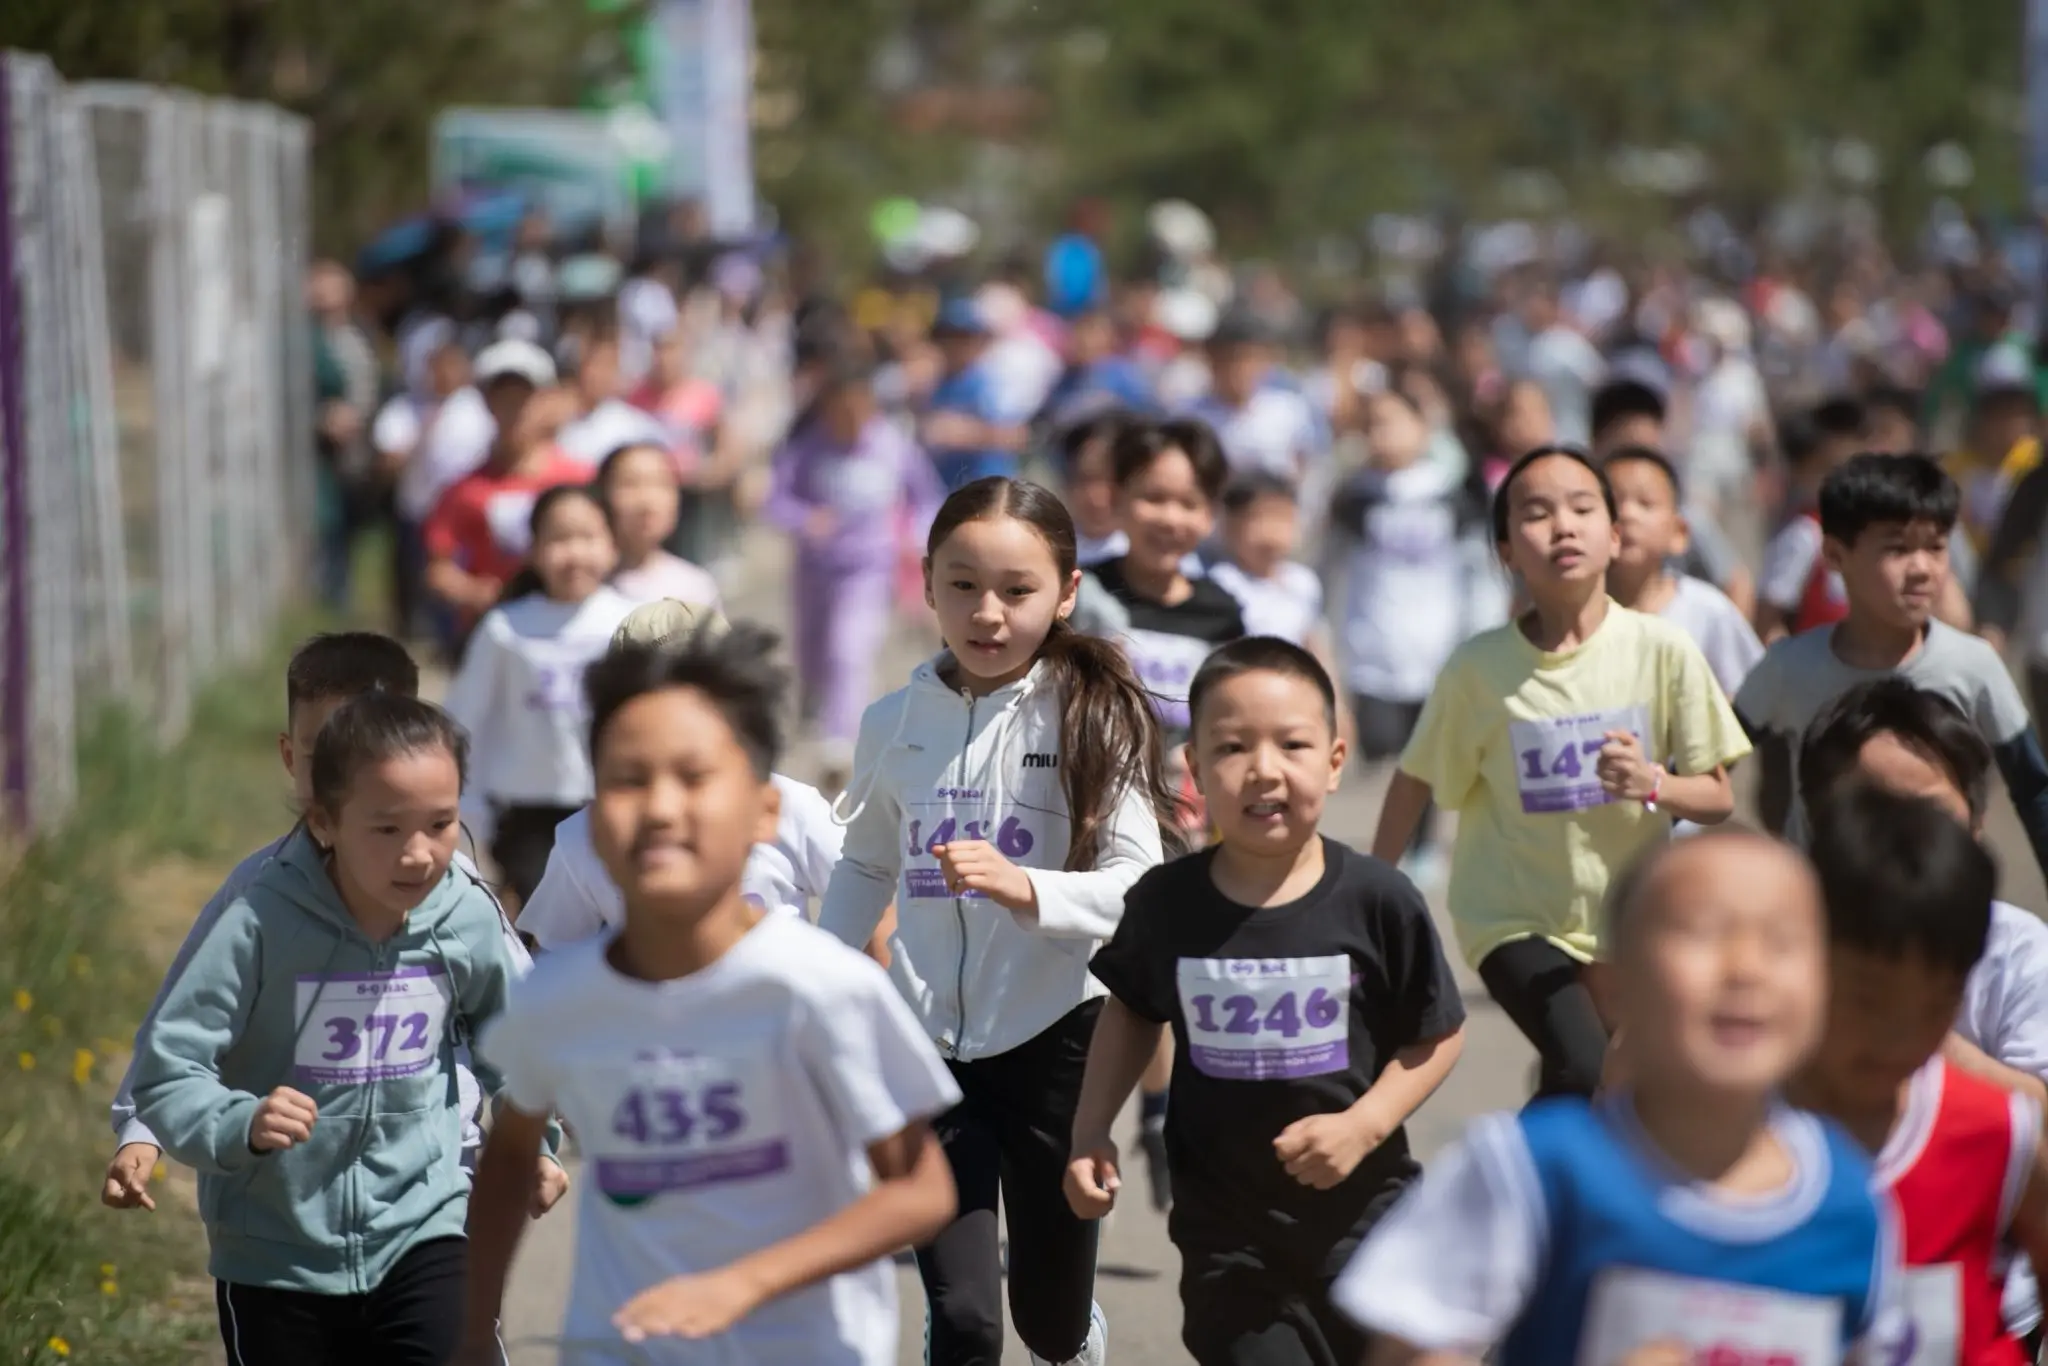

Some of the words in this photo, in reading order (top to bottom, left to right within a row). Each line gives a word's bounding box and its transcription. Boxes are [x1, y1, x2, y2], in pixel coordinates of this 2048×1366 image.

[322, 1012, 429, 1061] 372
[1191, 986, 1340, 1038] 1246
[612, 1079, 748, 1146] 435
